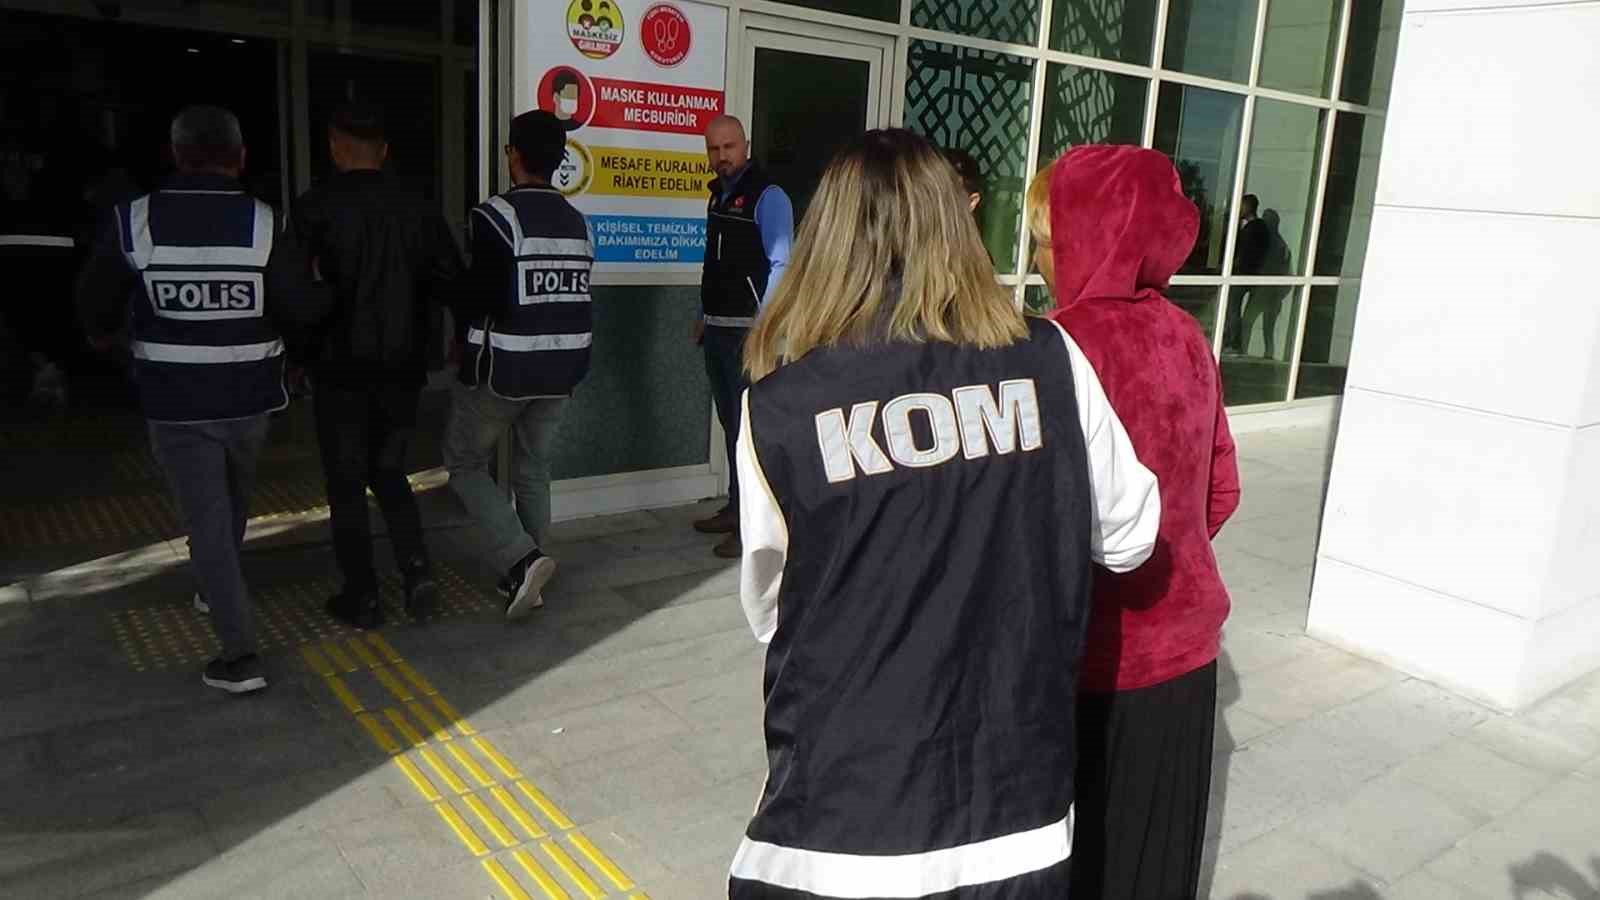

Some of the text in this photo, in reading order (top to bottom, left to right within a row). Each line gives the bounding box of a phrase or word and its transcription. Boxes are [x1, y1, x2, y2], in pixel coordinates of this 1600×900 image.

[573, 29, 618, 41] MASKESİZ
[601, 86, 719, 111] MASKE KULLANMAK
[624, 107, 697, 127] MECBURİDİR
[601, 156, 651, 172] MESAFE
[613, 173, 702, 192] RİAYET EDELİM
[597, 220, 643, 234] KİŞİSEL
[648, 222, 698, 234] TEMİZLİK
[598, 235, 706, 247] BAKIMIMIZA DİKKA
[635, 248, 678, 260] EDELİM
[815, 379, 1043, 483] KOM
